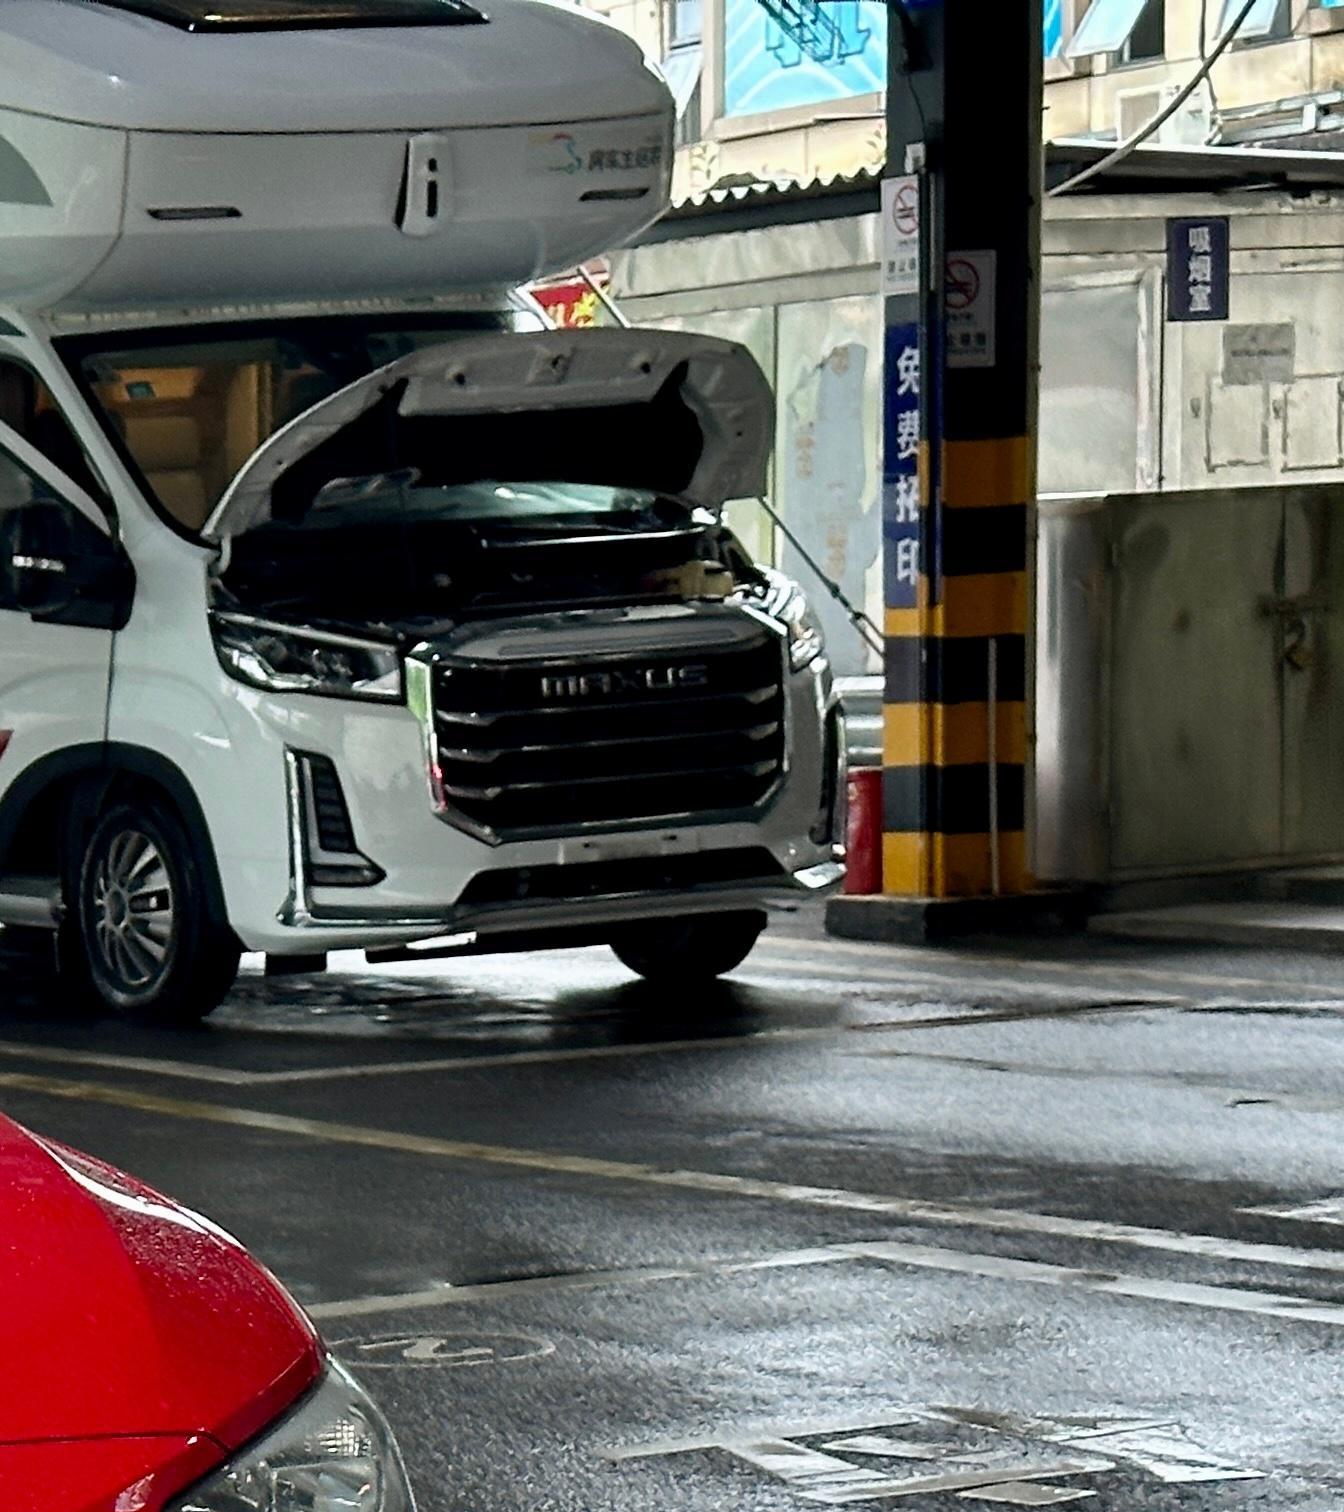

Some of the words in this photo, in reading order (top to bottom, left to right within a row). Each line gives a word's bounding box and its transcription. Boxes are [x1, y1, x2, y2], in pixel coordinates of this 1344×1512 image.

[1188, 227, 1212, 313] 吸烟室
[541, 665, 709, 698] MAXUS
